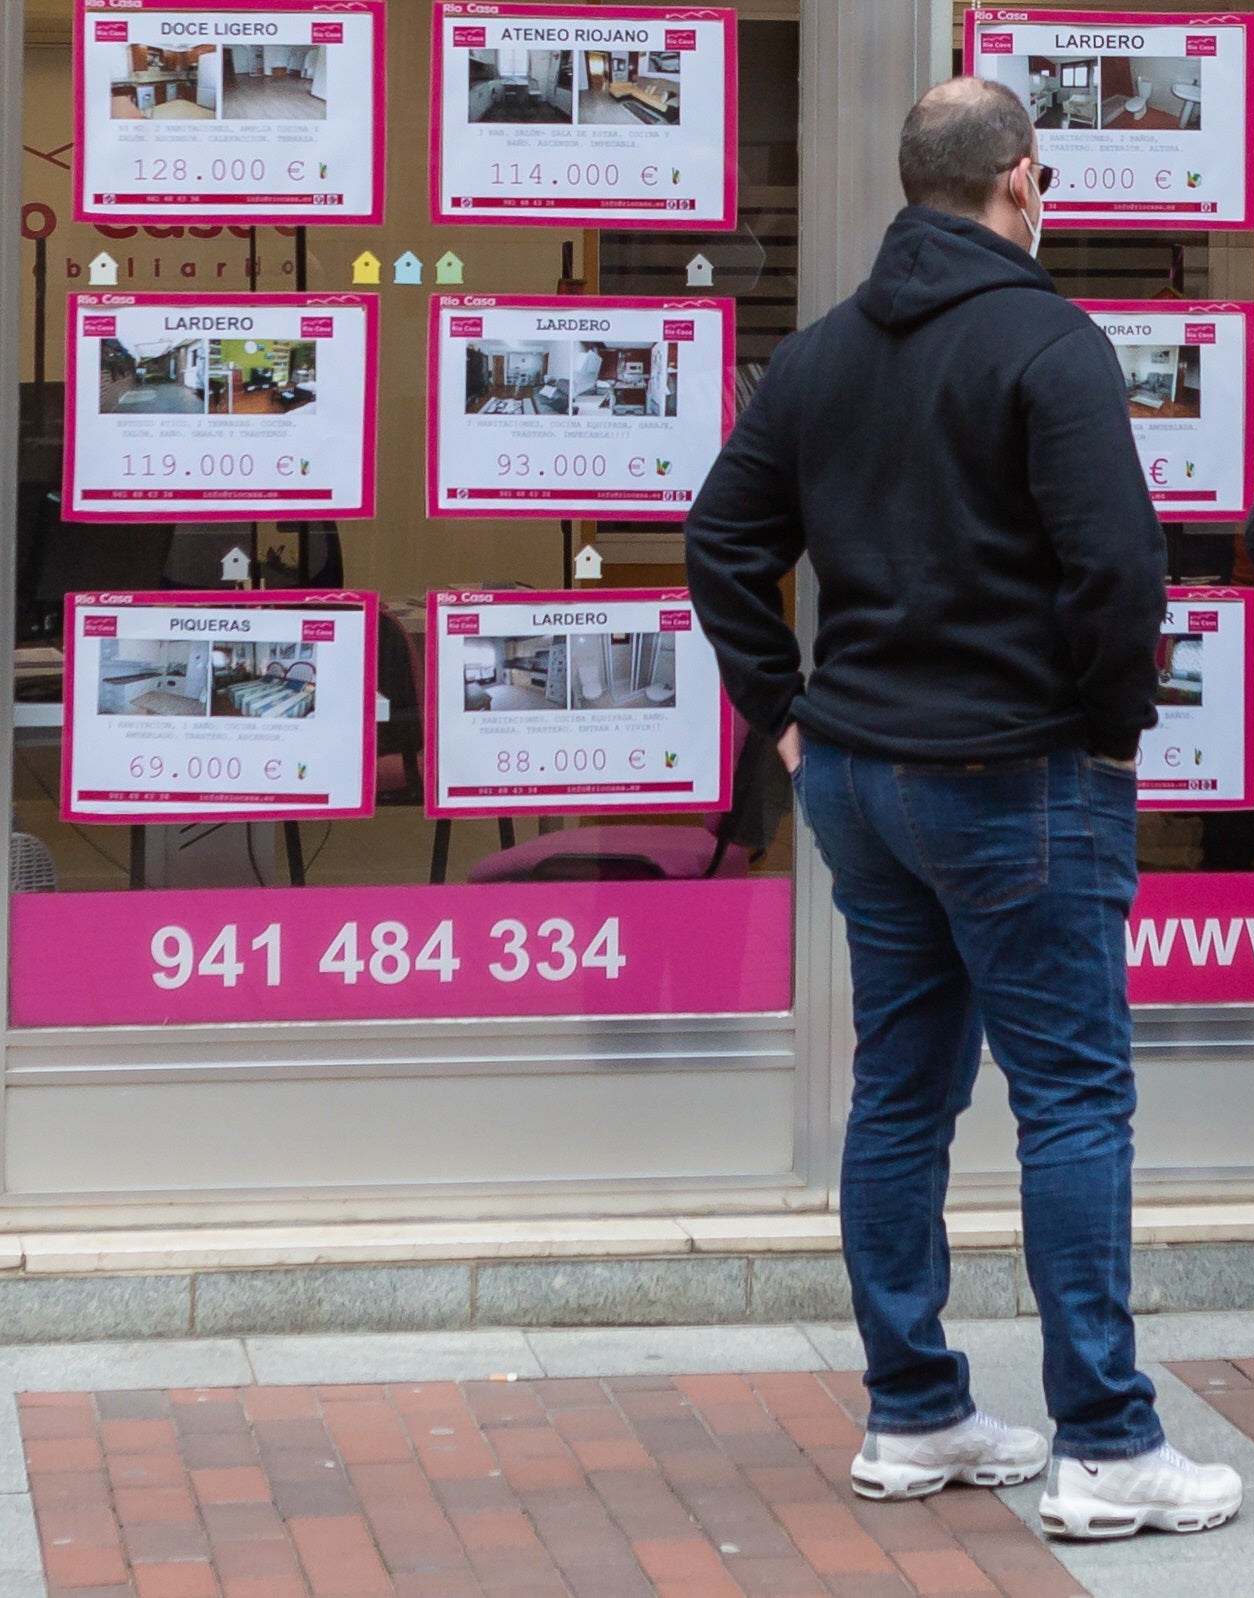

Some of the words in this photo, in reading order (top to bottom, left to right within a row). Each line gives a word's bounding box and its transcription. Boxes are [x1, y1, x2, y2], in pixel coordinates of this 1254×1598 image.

[974, 12, 992, 21] Rio
[998, 11, 1028, 21] Casa
[162, 22, 208, 35] DOCE
[215, 23, 277, 36] LIGERO
[502, 28, 569, 41] ATENEO
[575, 29, 648, 42] RIOJANO
[1056, 35, 1144, 49] LARDERO
[135, 159, 265, 181] 128.000
[287, 161, 304, 181] €
[492, 163, 618, 185] 114.000
[641, 166, 657, 186] €
[1155, 170, 1171, 189] €
[440, 296, 459, 306] Rio
[464, 296, 496, 306] Casa
[165, 317, 253, 330] LARDERO
[537, 319, 610, 331] LARDERO
[1103, 325, 1151, 336] ORATO
[123, 454, 253, 476] 119.000
[276, 456, 294, 476] €
[498, 454, 606, 476] 93.000
[628, 457, 645, 477] €
[1150, 458, 1168, 484] €
[170, 619, 250, 632] PIQUERAS
[533, 613, 607, 625] LARDERO
[497, 750, 606, 772] 88.000
[629, 749, 645, 769] €
[1165, 747, 1180, 766] €
[130, 756, 241, 779] 69.000
[264, 760, 281, 780] €
[151, 924, 280, 989] 941
[319, 920, 460, 984] 484
[489, 918, 626, 981] 334
